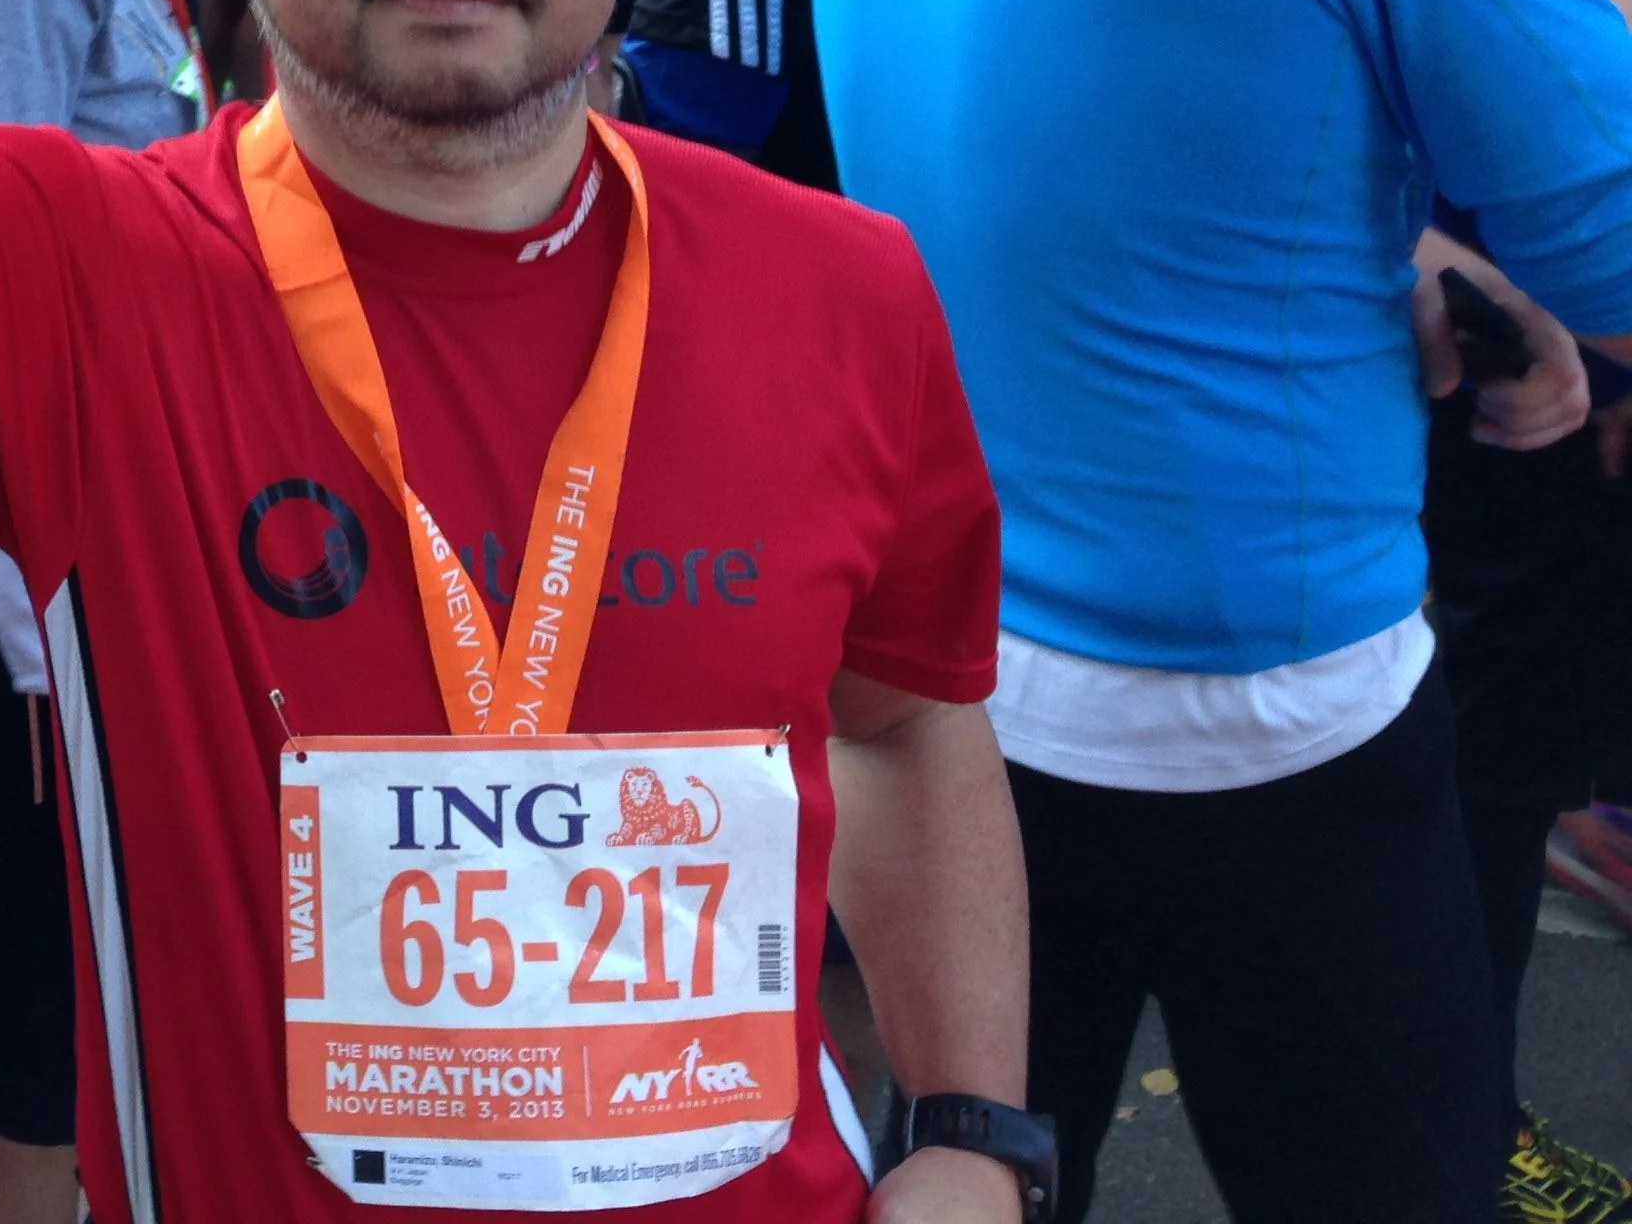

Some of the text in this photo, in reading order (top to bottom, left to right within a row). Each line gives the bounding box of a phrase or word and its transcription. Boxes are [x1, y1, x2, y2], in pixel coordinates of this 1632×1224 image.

[556, 464, 595, 530] THE
[542, 534, 580, 597] ING
[441, 568, 480, 647] NEW
[522, 605, 564, 690] NEW
[388, 782, 591, 850] ING
[288, 814, 317, 963] WAVE 4
[379, 862, 730, 1008] 65-217
[325, 1061, 564, 1097] MARATHON
[326, 1041, 562, 1063] THE ING NEW YORK CITY
[326, 1096, 564, 1121] NOVEMBER 3, 2013
[571, 1165, 589, 1184] For
[590, 1163, 629, 1182] Medical
[683, 1155, 699, 1173] call
